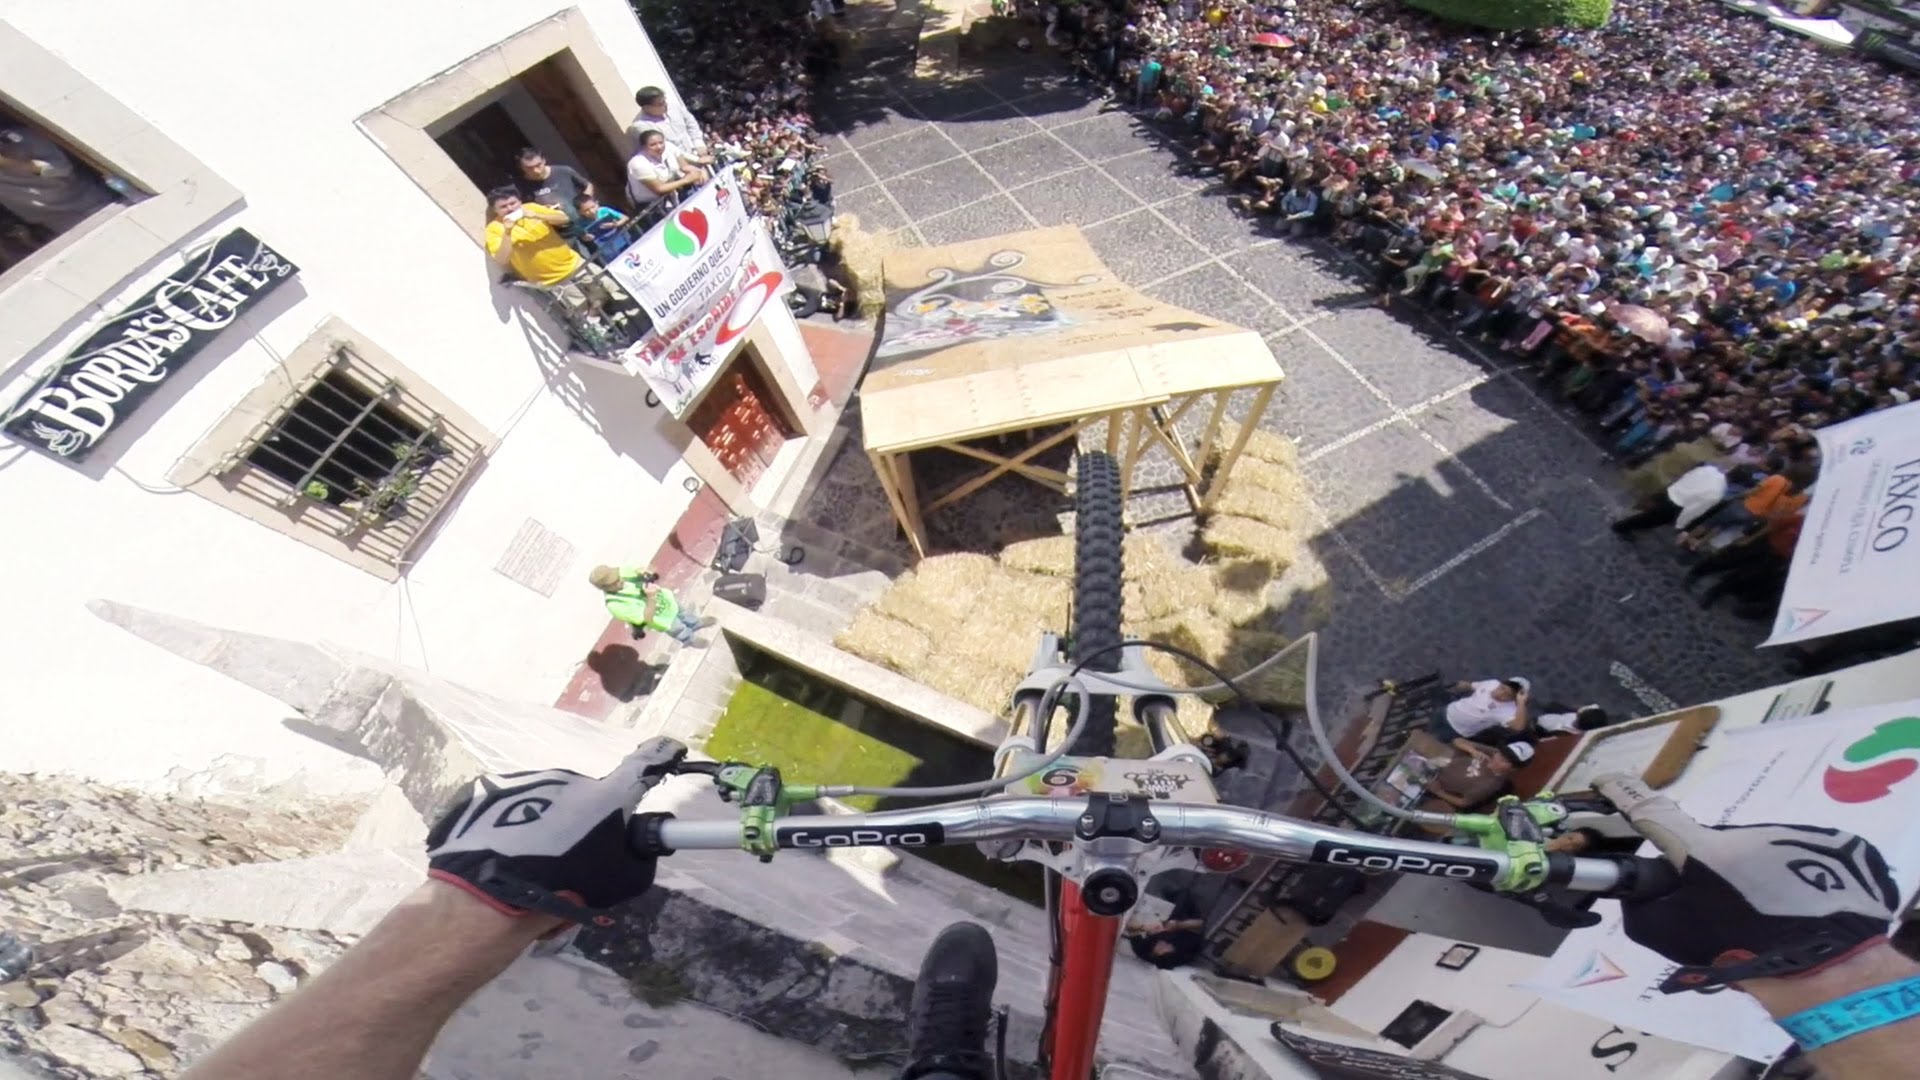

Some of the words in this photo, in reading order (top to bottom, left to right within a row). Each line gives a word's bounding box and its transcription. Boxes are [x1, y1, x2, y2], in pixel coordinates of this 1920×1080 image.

[653, 299, 675, 319] UN
[669, 262, 710, 306] GOBIERNO
[708, 247, 723, 268] QUE
[699, 266, 732, 302] TAXCO
[689, 289, 737, 347] ESCRIBE
[1873, 458, 1920, 552] TAXCO
[791, 830, 926, 848] GoPro
[1327, 848, 1476, 878] GoPro
[1590, 1025, 1650, 1073] S
